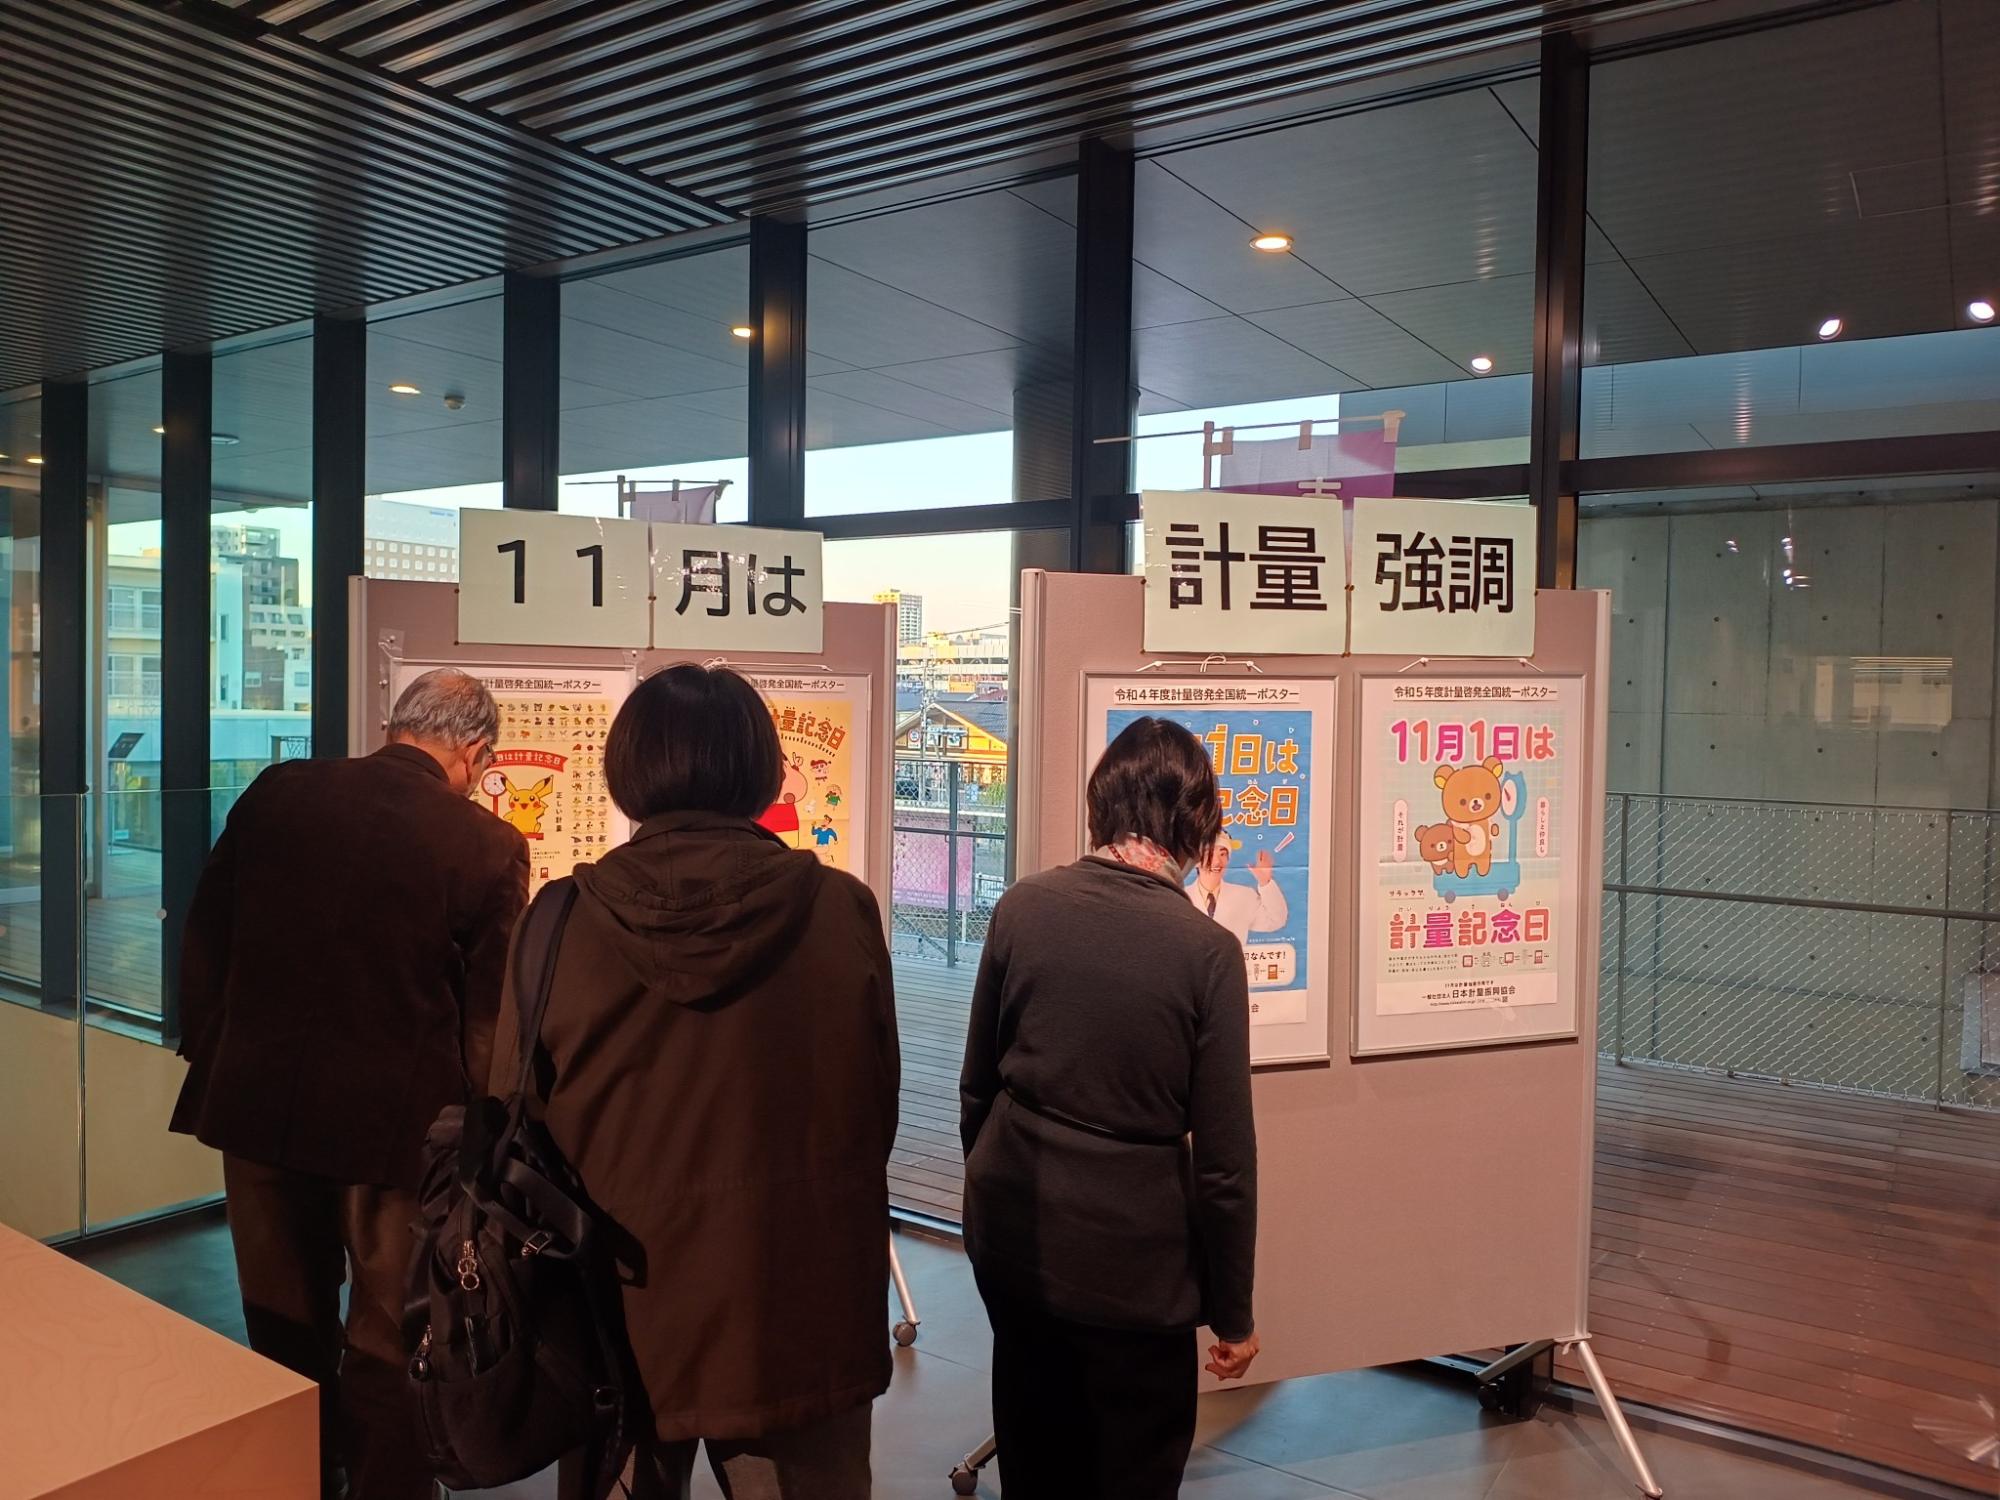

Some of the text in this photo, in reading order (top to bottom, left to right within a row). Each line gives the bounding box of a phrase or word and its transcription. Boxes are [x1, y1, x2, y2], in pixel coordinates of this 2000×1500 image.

[1164, 521, 1515, 615] 計量 強調
[1114, 687, 1300, 702] 令和4年度計量啓発全国統一ポスター
[1393, 685, 1558, 699] 令和5年度計量啓発全国統一ポスター
[1390, 719, 1556, 763] 11月1日は
[1389, 908, 1550, 950] 計量記念日
